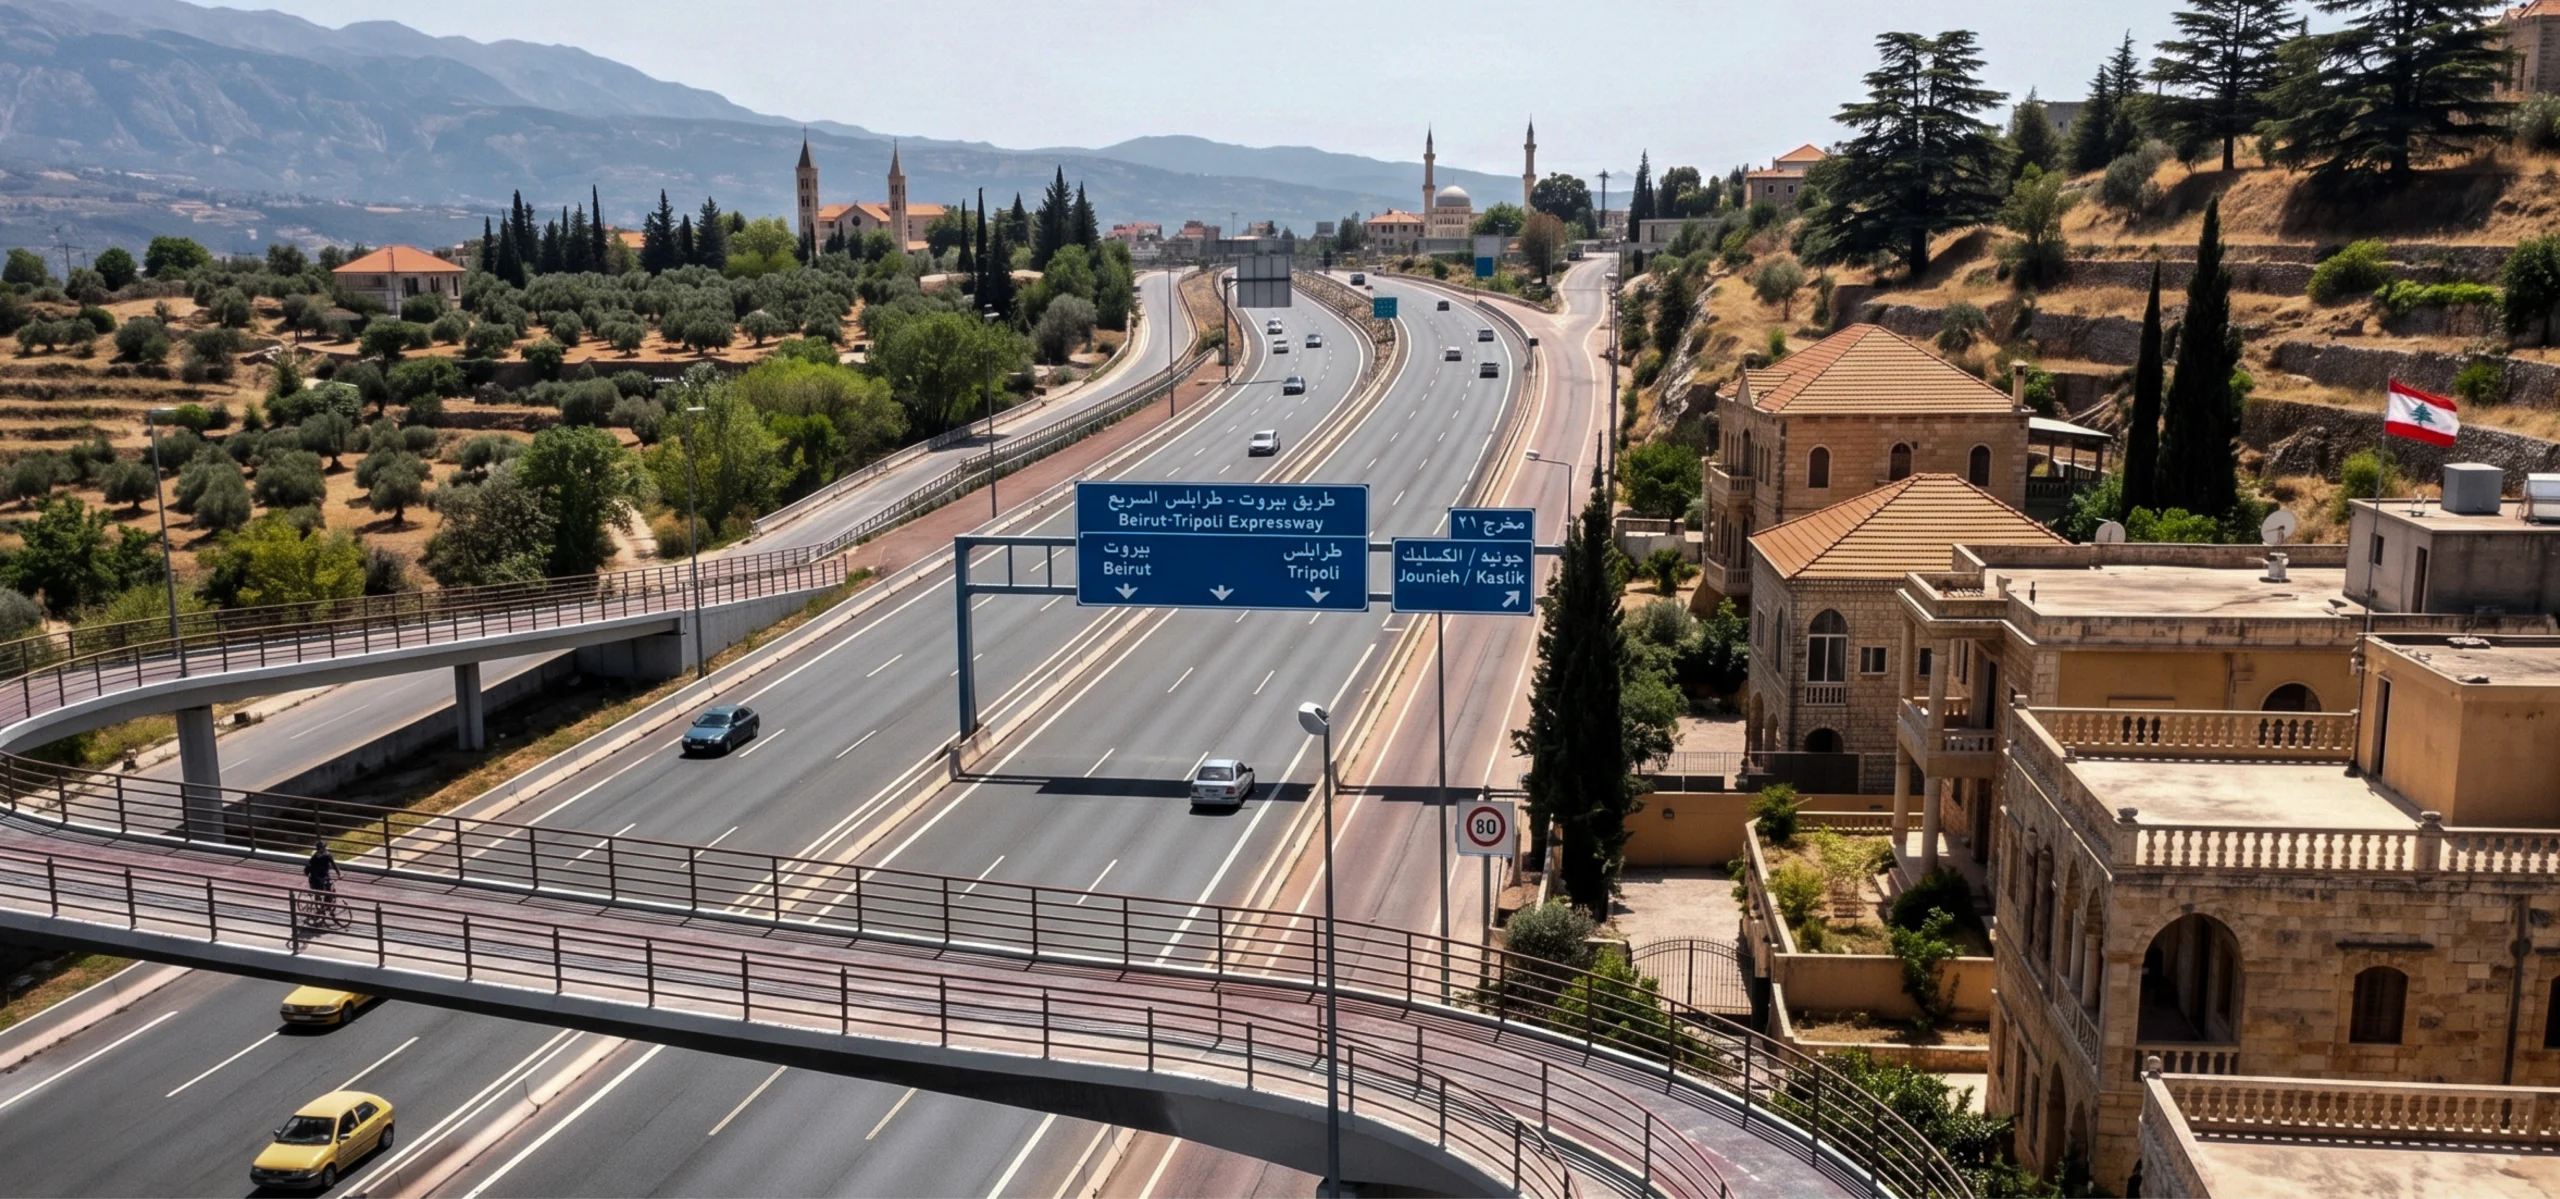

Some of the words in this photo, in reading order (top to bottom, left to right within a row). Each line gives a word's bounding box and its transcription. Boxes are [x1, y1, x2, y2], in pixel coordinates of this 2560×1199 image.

[1108, 490, 1158, 511] السريع
[1165, 490, 1223, 509] طرابلس
[1239, 495, 1287, 511] بيروت
[1293, 491, 1335, 512] طريق
[1119, 513, 1223, 531] Beirut-Tripoli
[1229, 515, 1323, 533] Expressway
[1483, 516, 1525, 537] مخرج
[1103, 542, 1150, 558] بيروت
[1283, 542, 1342, 561] طرابلس
[1402, 547, 1463, 566] الكسليك
[1468, 547, 1476, 566] /
[1481, 551, 1524, 567] جونيه
[1103, 561, 1151, 576] Beirut
[1287, 565, 1340, 582] Tripoli
[1398, 568, 1460, 583] Jounieh
[1463, 568, 1471, 586] /
[1476, 570, 1525, 585] Kaslik
[1476, 818, 1497, 835] 80
